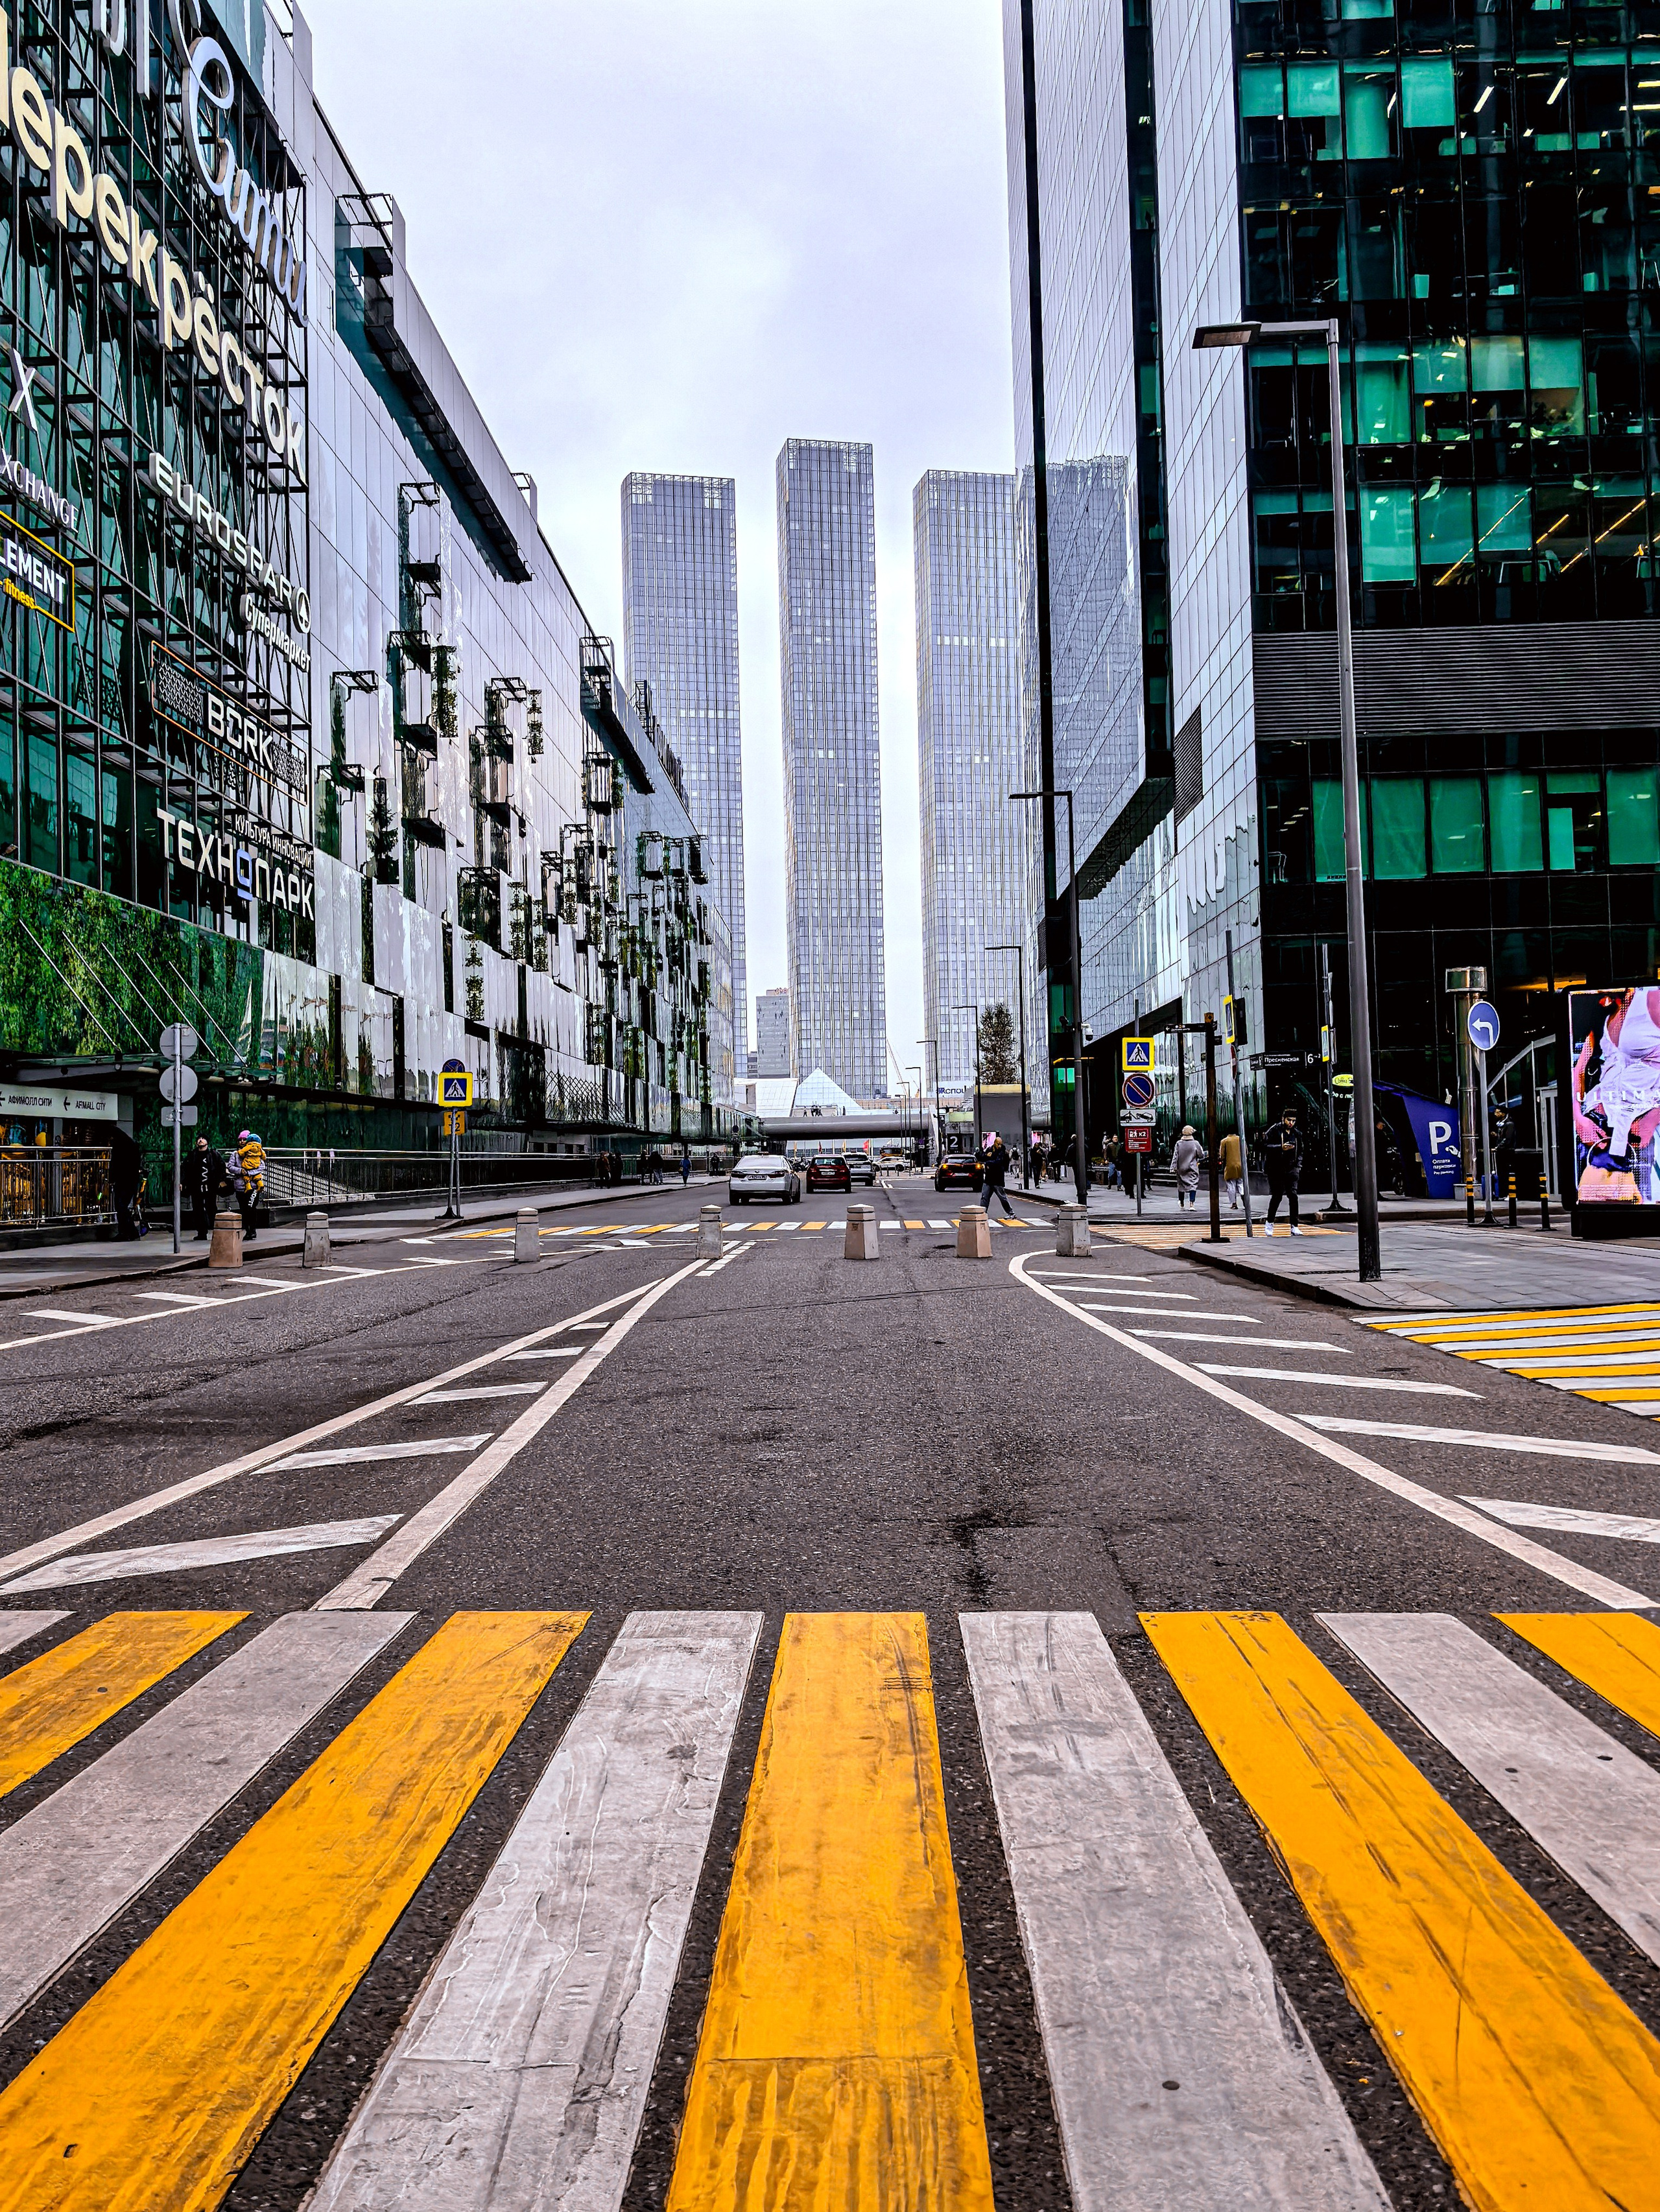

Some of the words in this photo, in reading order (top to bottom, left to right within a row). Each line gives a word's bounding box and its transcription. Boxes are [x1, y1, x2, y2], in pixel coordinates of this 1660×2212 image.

[149, 452, 292, 610] EUROSPAR
[3, 578, 35, 609] fitness
[235, 814, 271, 849] КУЛЬТУРА
[272, 834, 313, 868] ИННОВАЦИЙ
[156, 807, 314, 921] ТЕХНОПАРК
[8, 1095, 38, 1106] АФИМОЛЛ
[38, 1097, 53, 1107] СИТИ
[75, 1100, 95, 1110] AFIMALL
[95, 1102, 106, 1111] CITY
[950, 1136, 958, 1147] 2
[1429, 1121, 1452, 1155] P
